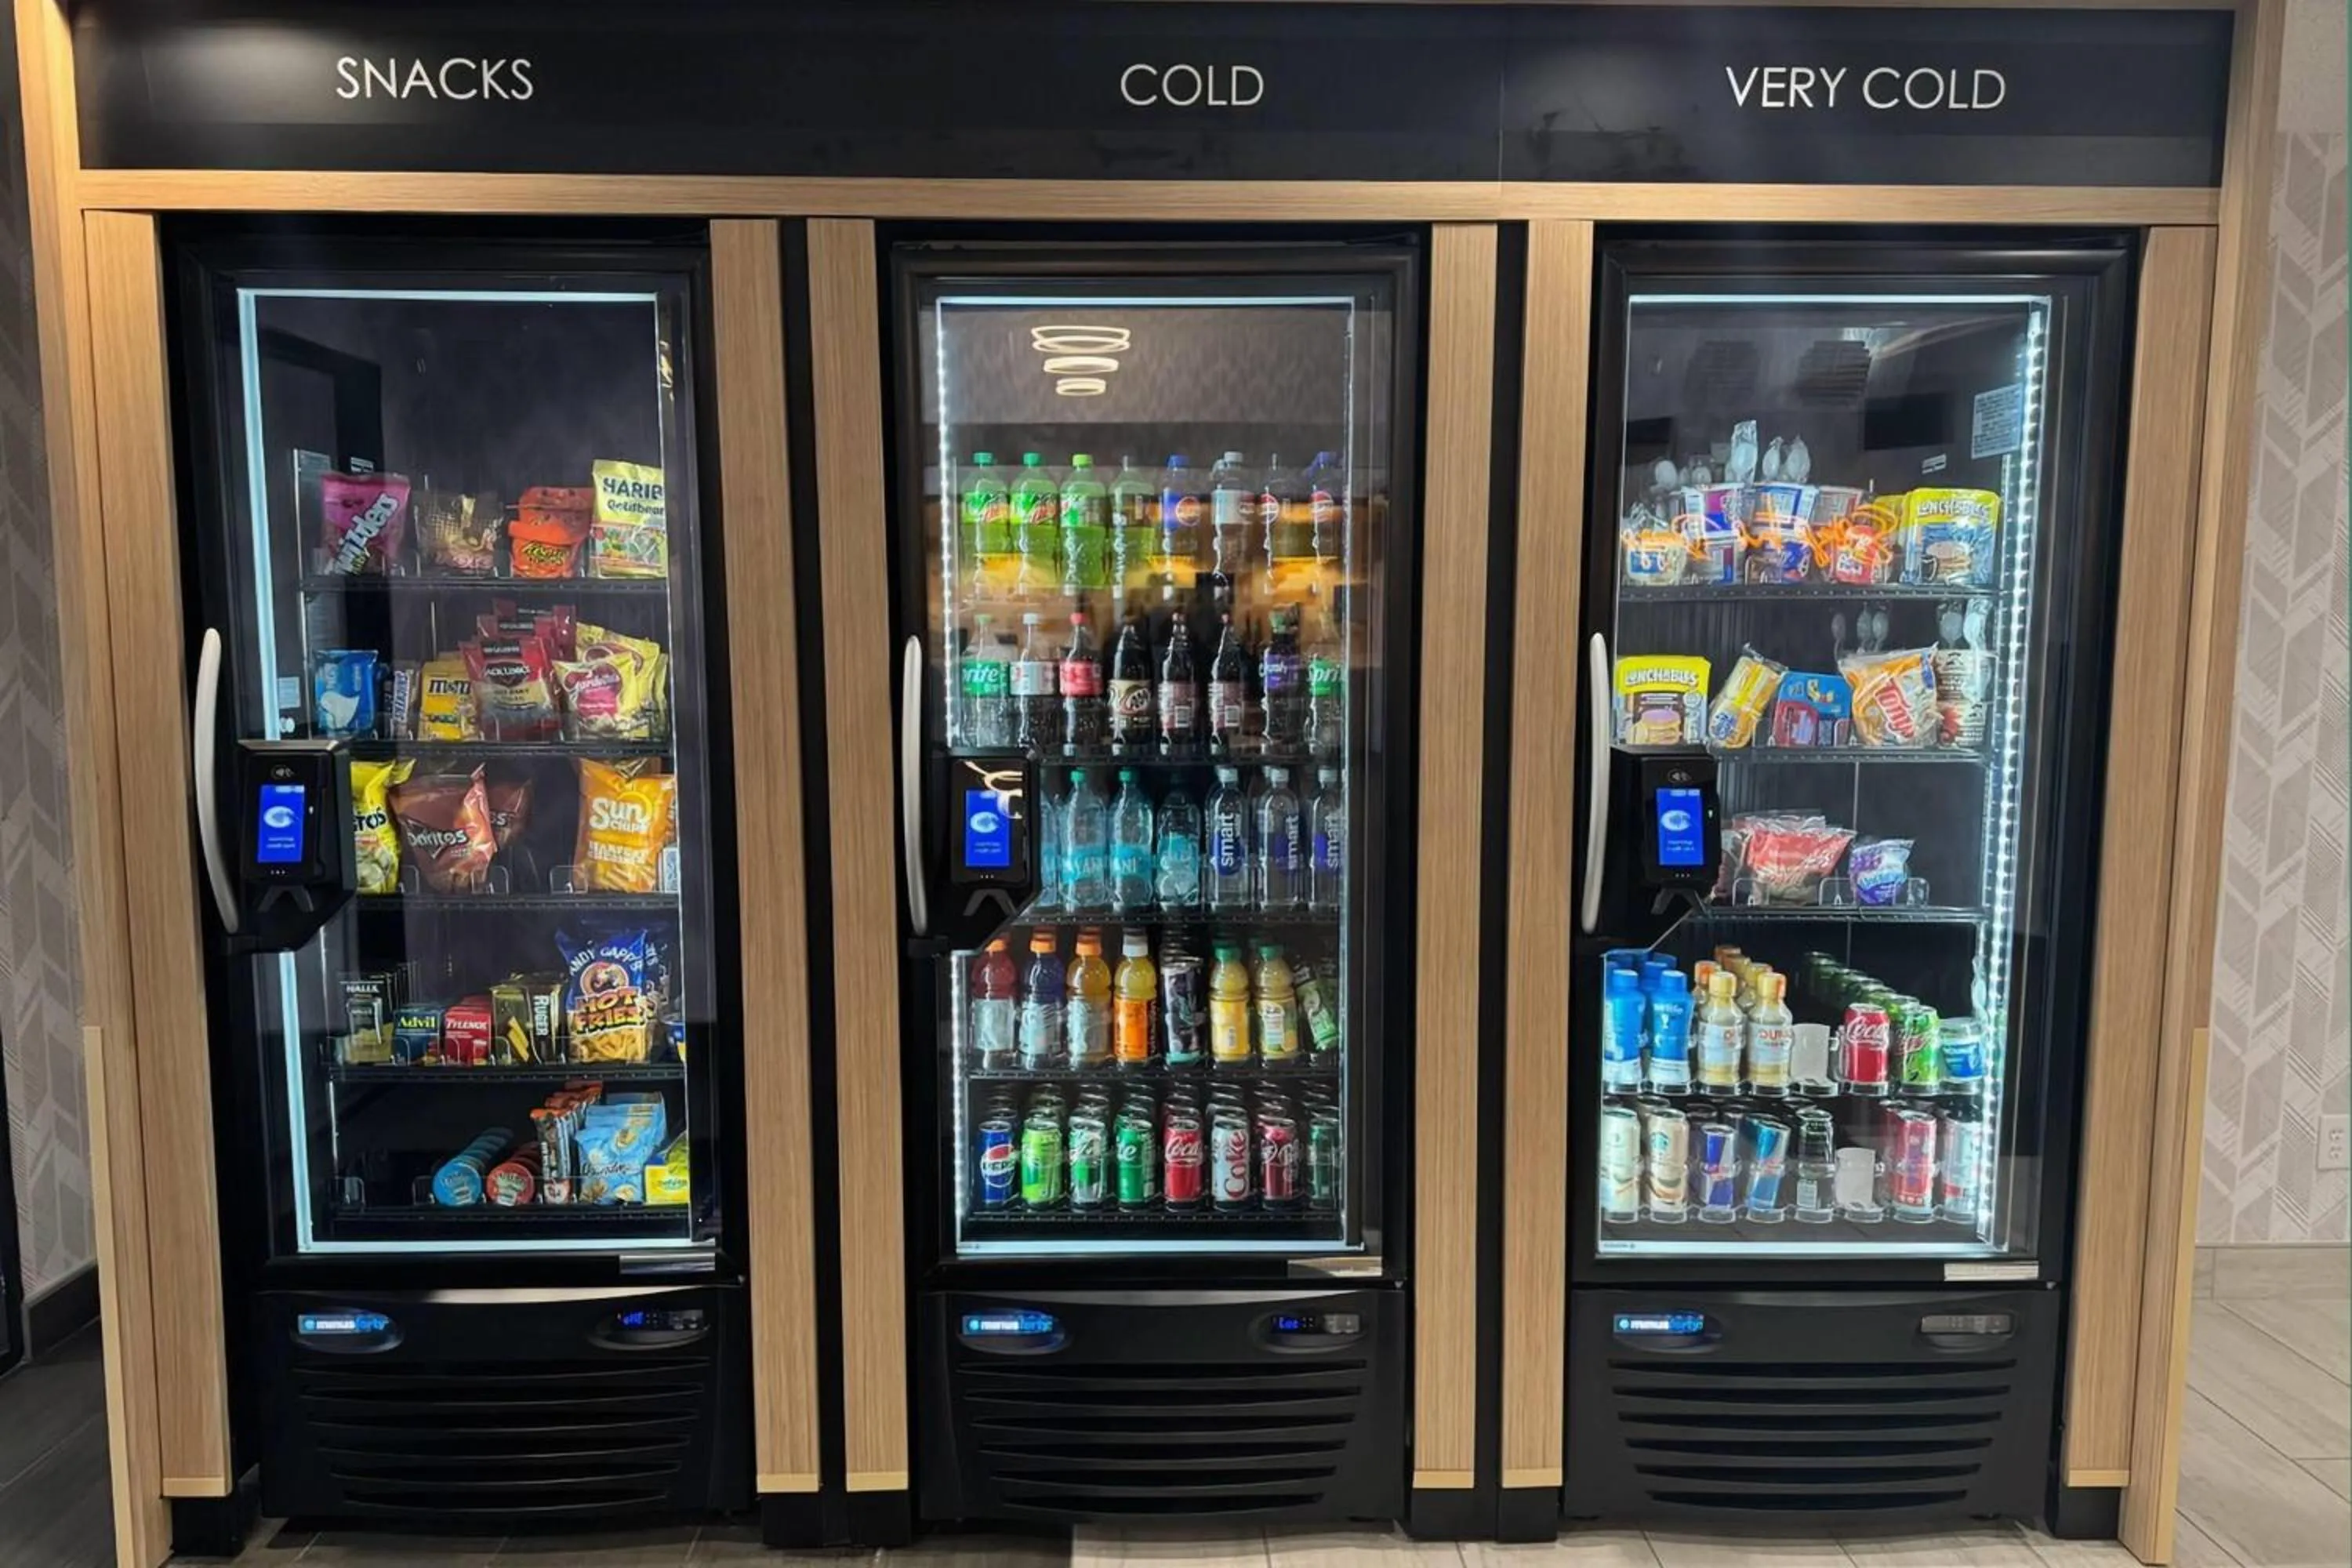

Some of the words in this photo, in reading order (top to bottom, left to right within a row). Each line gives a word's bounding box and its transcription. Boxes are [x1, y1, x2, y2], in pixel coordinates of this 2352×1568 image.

[336, 56, 534, 100] SNACKS
[1120, 64, 1265, 107] COLD
[1726, 66, 1847, 108] VERY
[1862, 67, 2007, 110] COLD
[602, 477, 662, 499] HARIB
[608, 499, 664, 515] Goldbear
[591, 798, 651, 829] Sun
[407, 830, 467, 847] Doritos
[1221, 812, 1235, 867] smart
[399, 1017, 436, 1028] Advil
